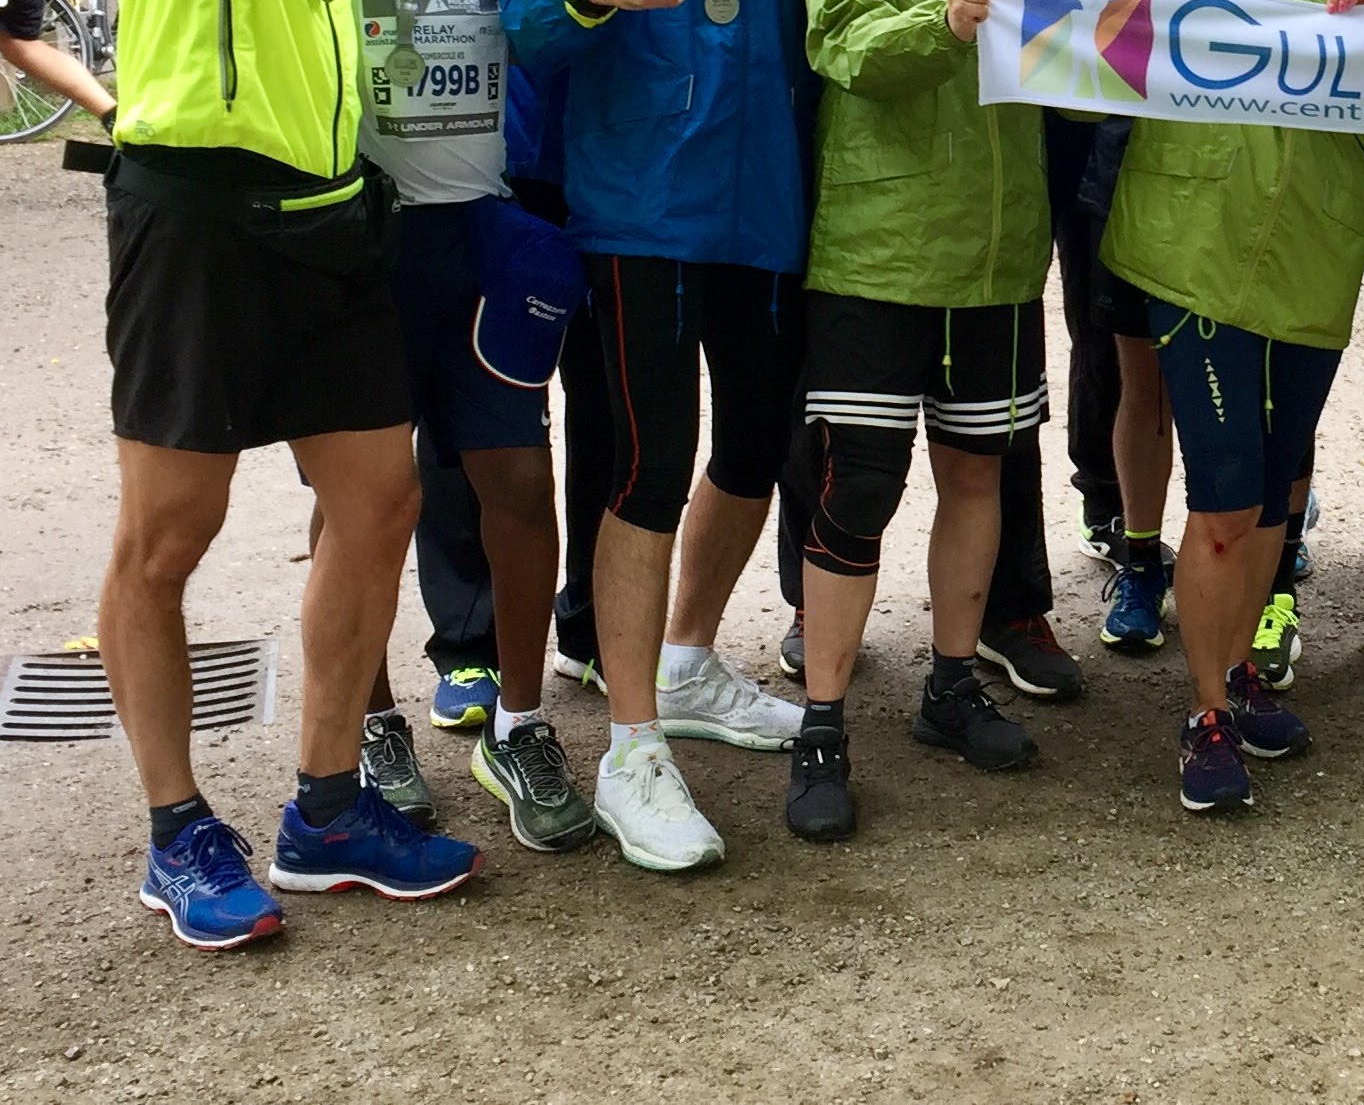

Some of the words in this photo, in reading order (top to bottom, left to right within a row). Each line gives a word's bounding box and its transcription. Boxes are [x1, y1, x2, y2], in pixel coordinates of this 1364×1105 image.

[413, 24, 456, 35] RELAY
[413, 34, 476, 45] MARATHON
[400, 121, 443, 132] UNDER
[446, 118, 495, 130] ARMOUR
